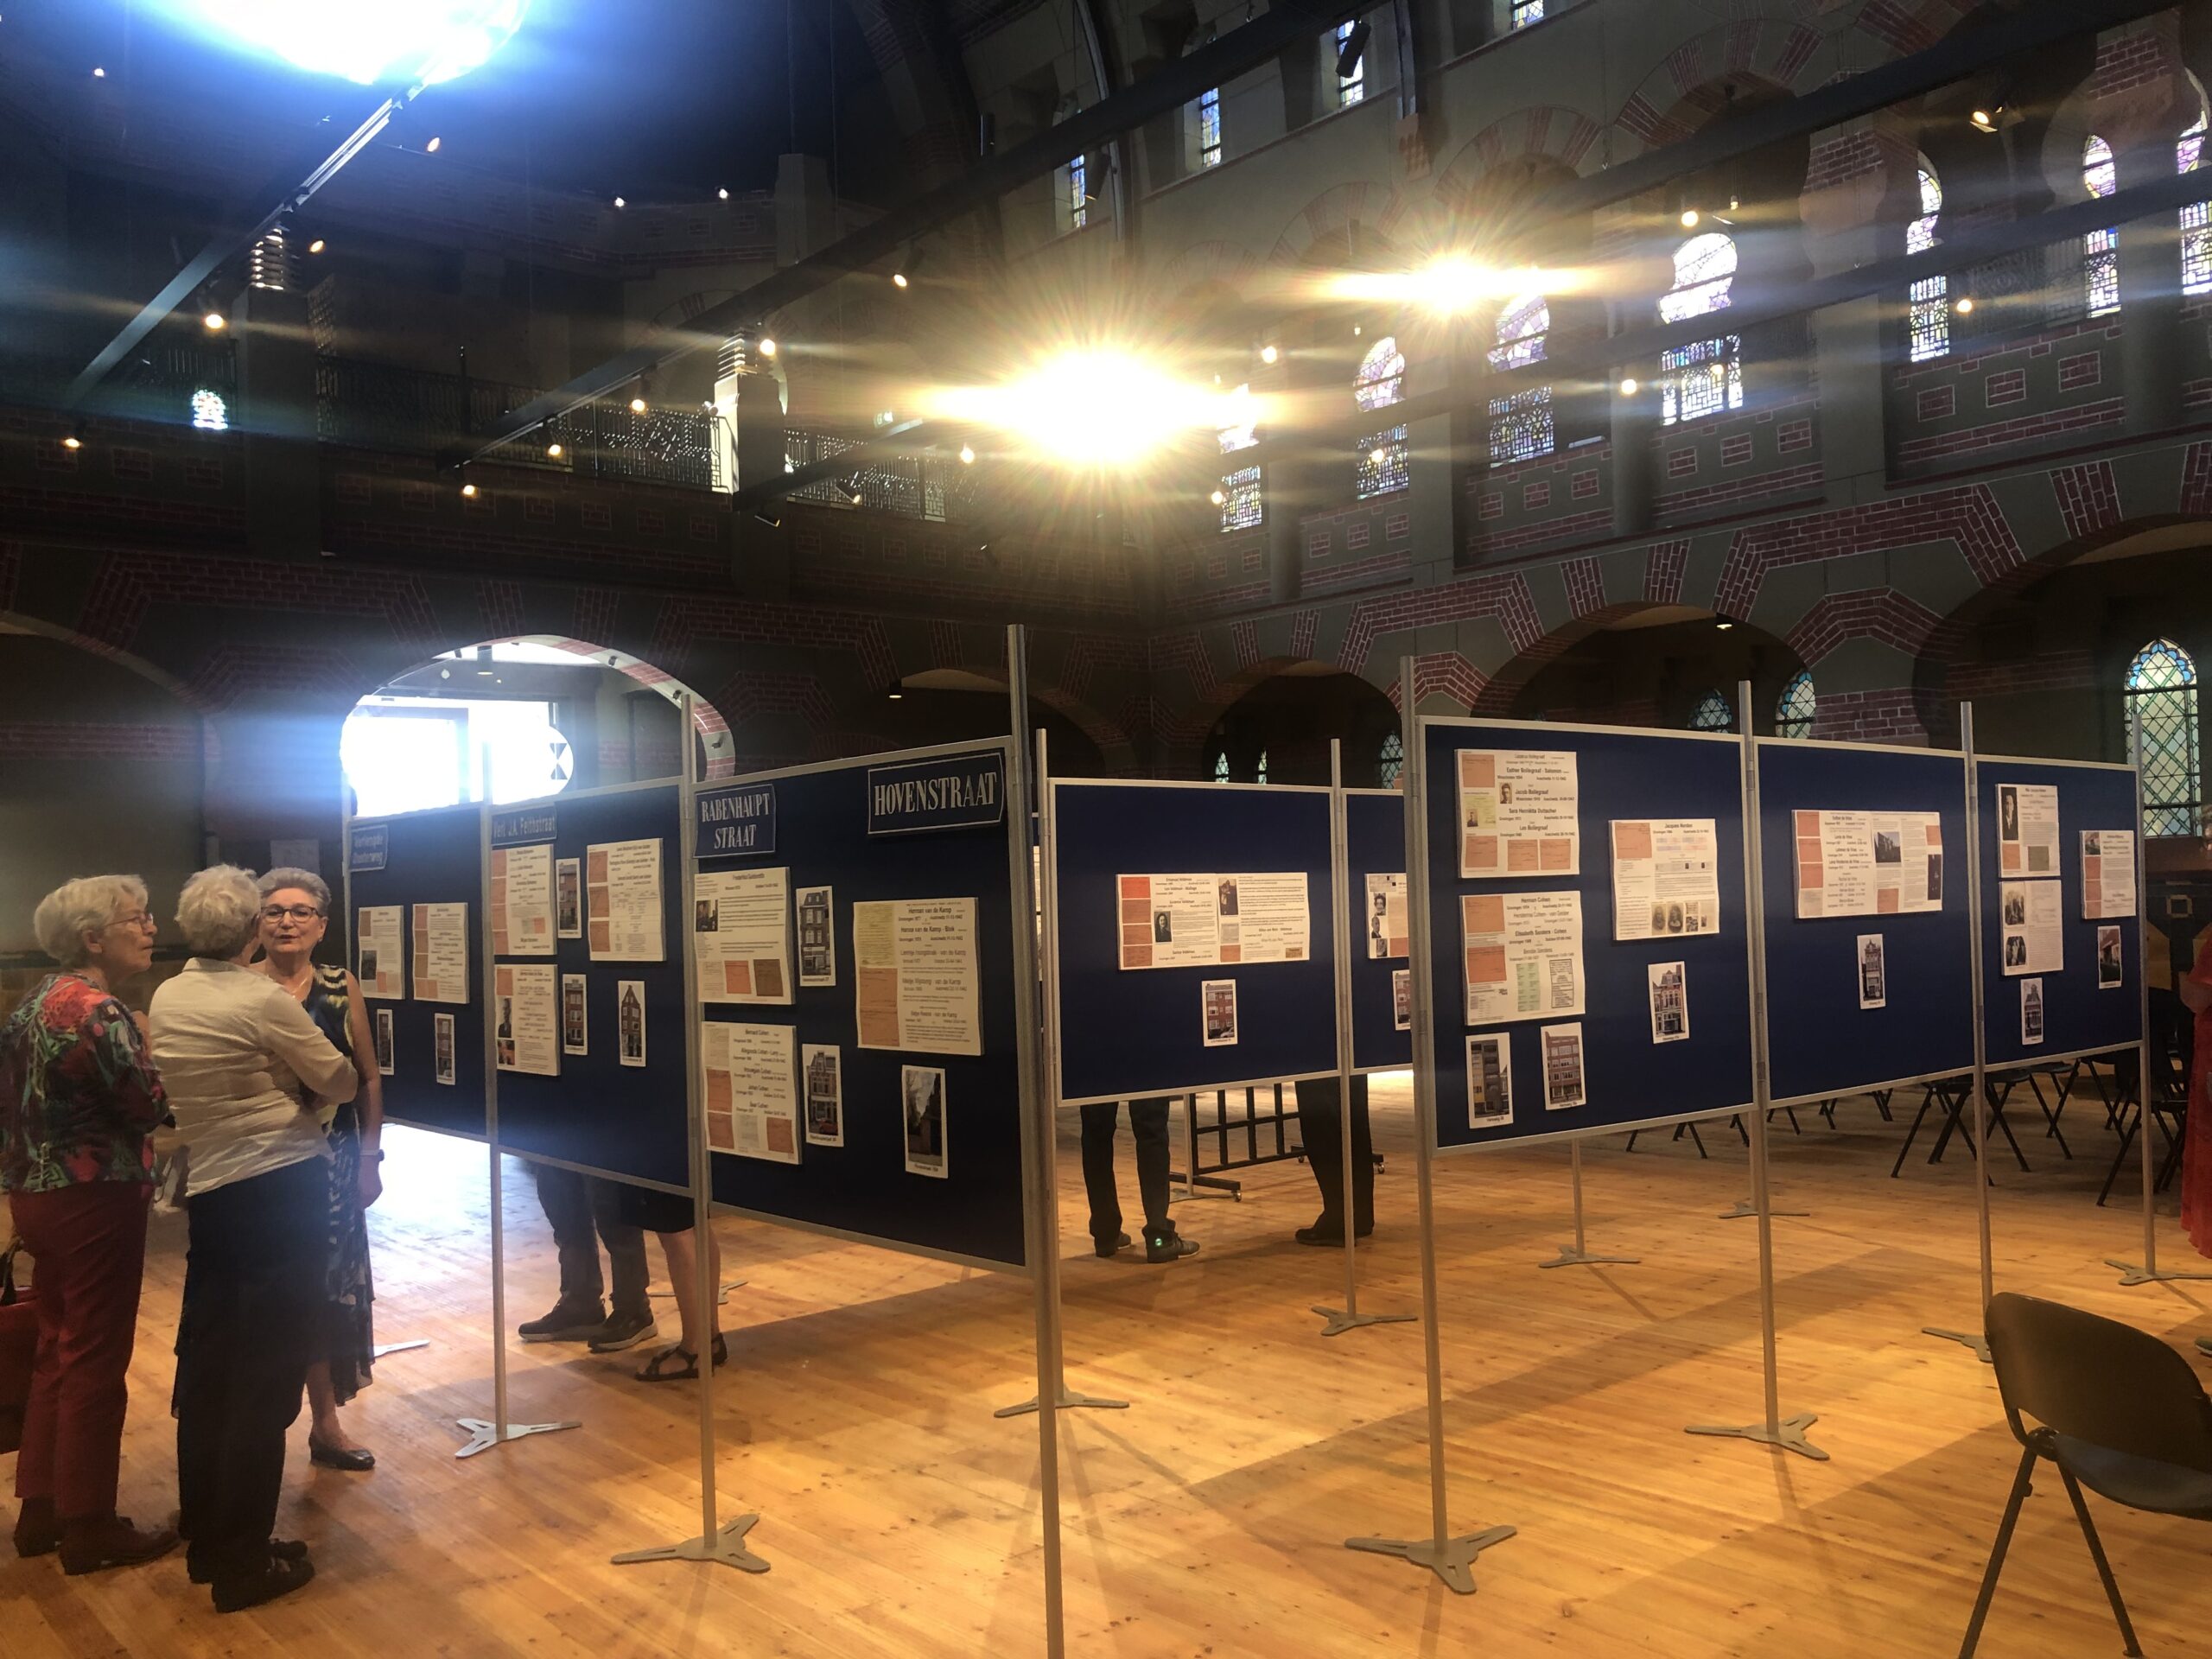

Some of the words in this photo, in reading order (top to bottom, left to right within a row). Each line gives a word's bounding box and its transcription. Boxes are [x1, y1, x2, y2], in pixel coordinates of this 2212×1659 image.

[701, 793, 770, 823] RABENHAUPT
[874, 772, 997, 816] HOVENSTRAAT
[714, 824, 756, 849] STRAAT
